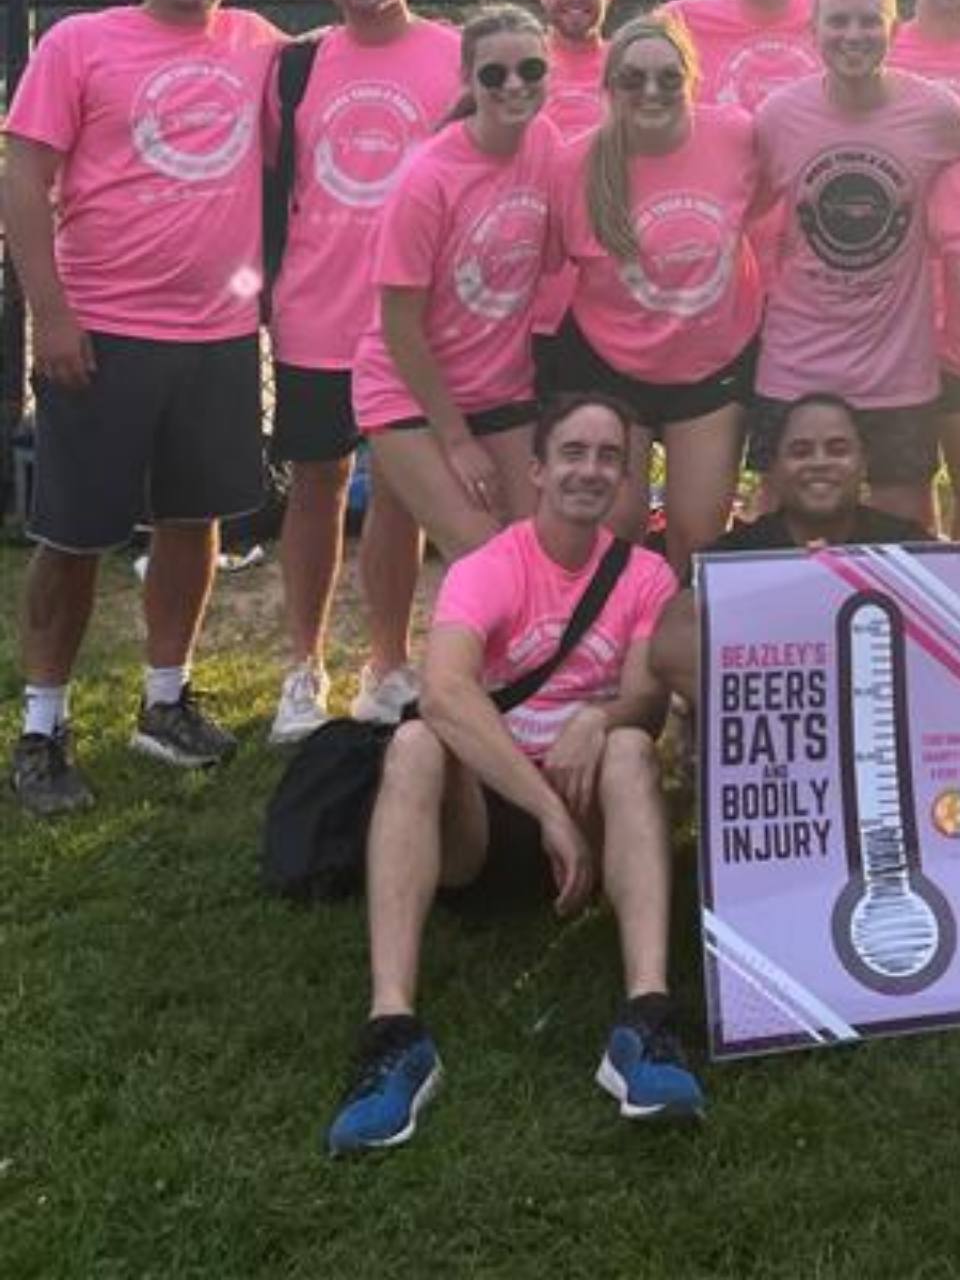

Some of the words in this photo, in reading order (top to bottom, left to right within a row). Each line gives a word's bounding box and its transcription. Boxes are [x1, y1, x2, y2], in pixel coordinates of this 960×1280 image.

[721, 643, 827, 666] BEAZLEY'S
[722, 672, 826, 711] BEERS
[721, 714, 827, 765] BATS
[722, 778, 829, 820] BODILY
[722, 819, 831, 863] INJURY
